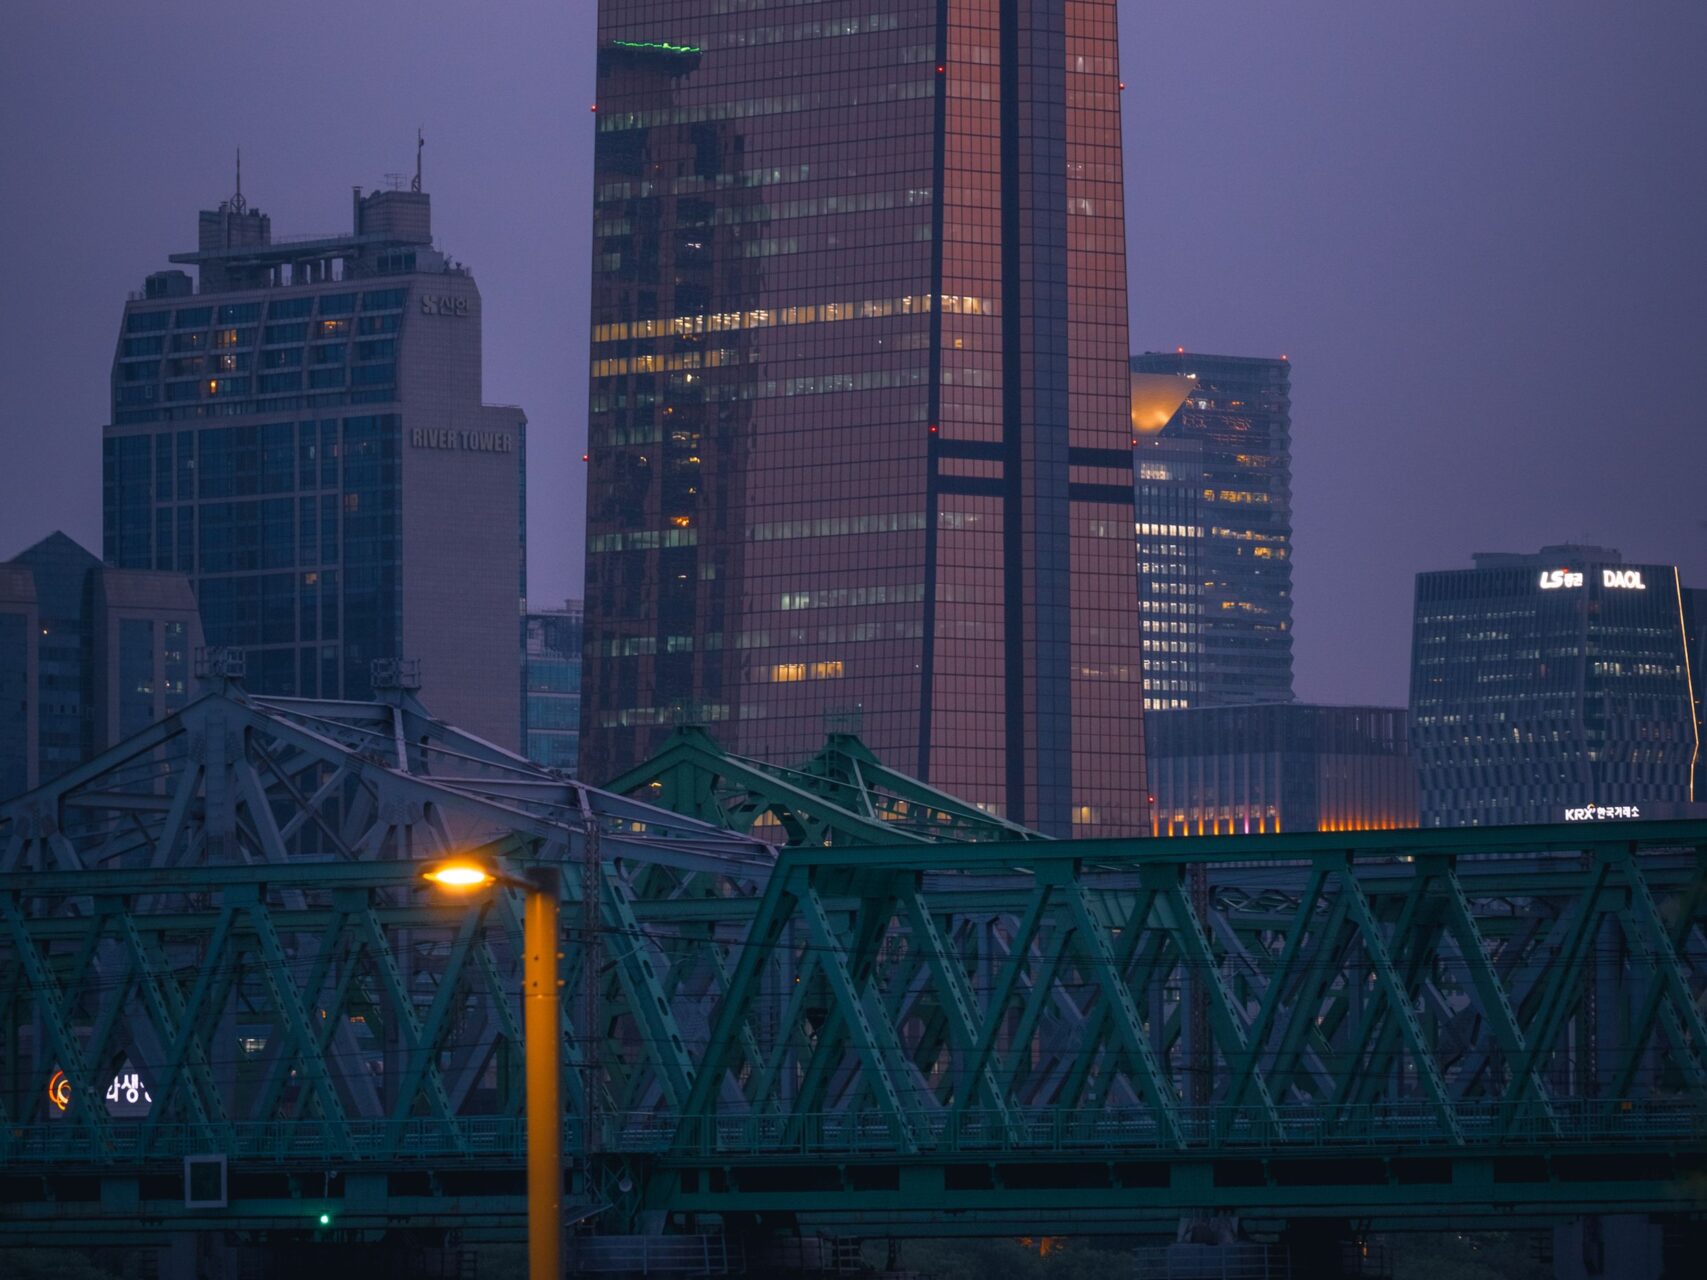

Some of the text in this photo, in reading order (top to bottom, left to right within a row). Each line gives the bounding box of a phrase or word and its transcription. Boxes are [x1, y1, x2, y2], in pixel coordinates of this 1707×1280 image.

[412, 428, 512, 453] RIVER TOWER
[1603, 570, 1646, 589] DAOL
[1565, 806, 1640, 821] KRX 한국거래소
